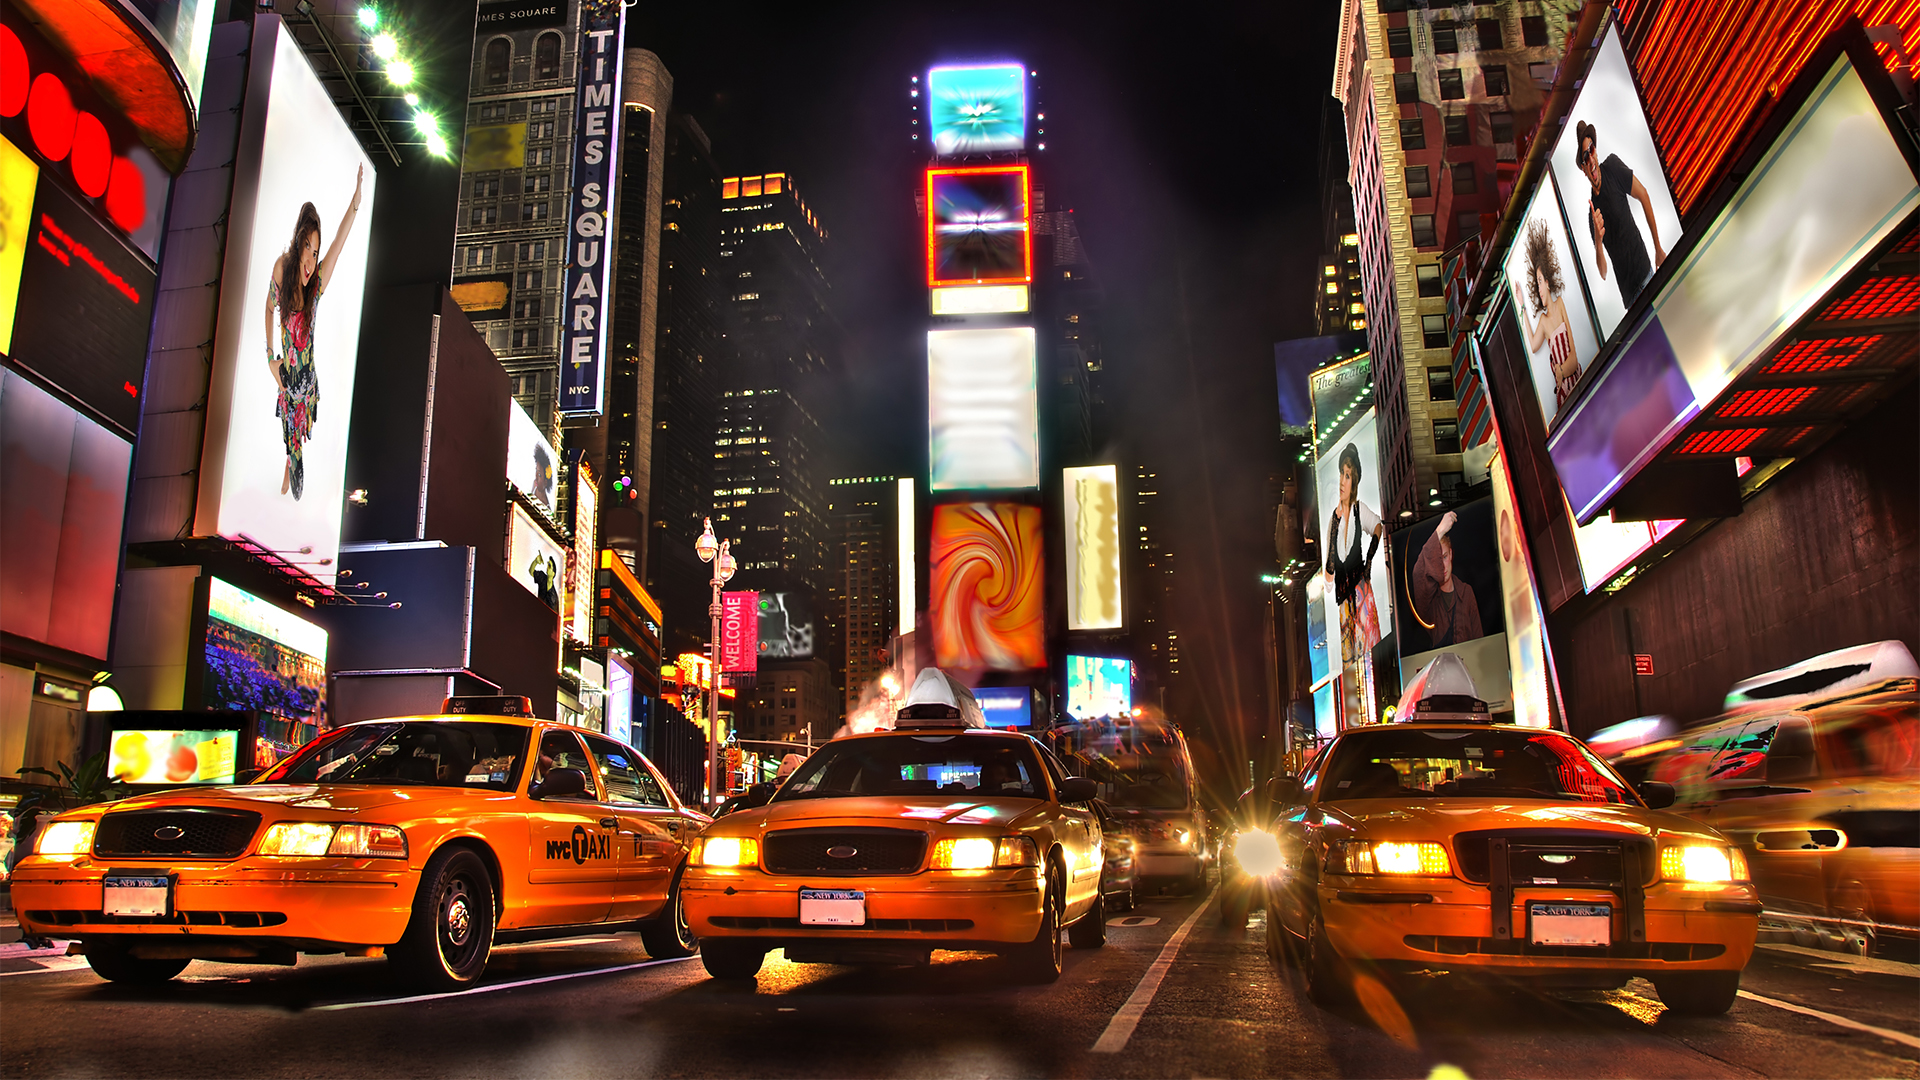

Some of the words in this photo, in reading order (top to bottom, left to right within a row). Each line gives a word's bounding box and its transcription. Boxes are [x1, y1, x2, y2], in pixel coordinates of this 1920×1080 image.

[510, 6, 557, 19] SQUARE
[584, 29, 614, 165] TIMES
[570, 182, 604, 363] SQUARE
[569, 386, 590, 395] NYC
[1316, 375, 1333, 390] The
[725, 597, 741, 669] WELCOME
[546, 841, 571, 859] NYC
[573, 829, 610, 862] TAXI
[1549, 907, 1567, 915] NEW
[1570, 908, 1591, 916] YORK
